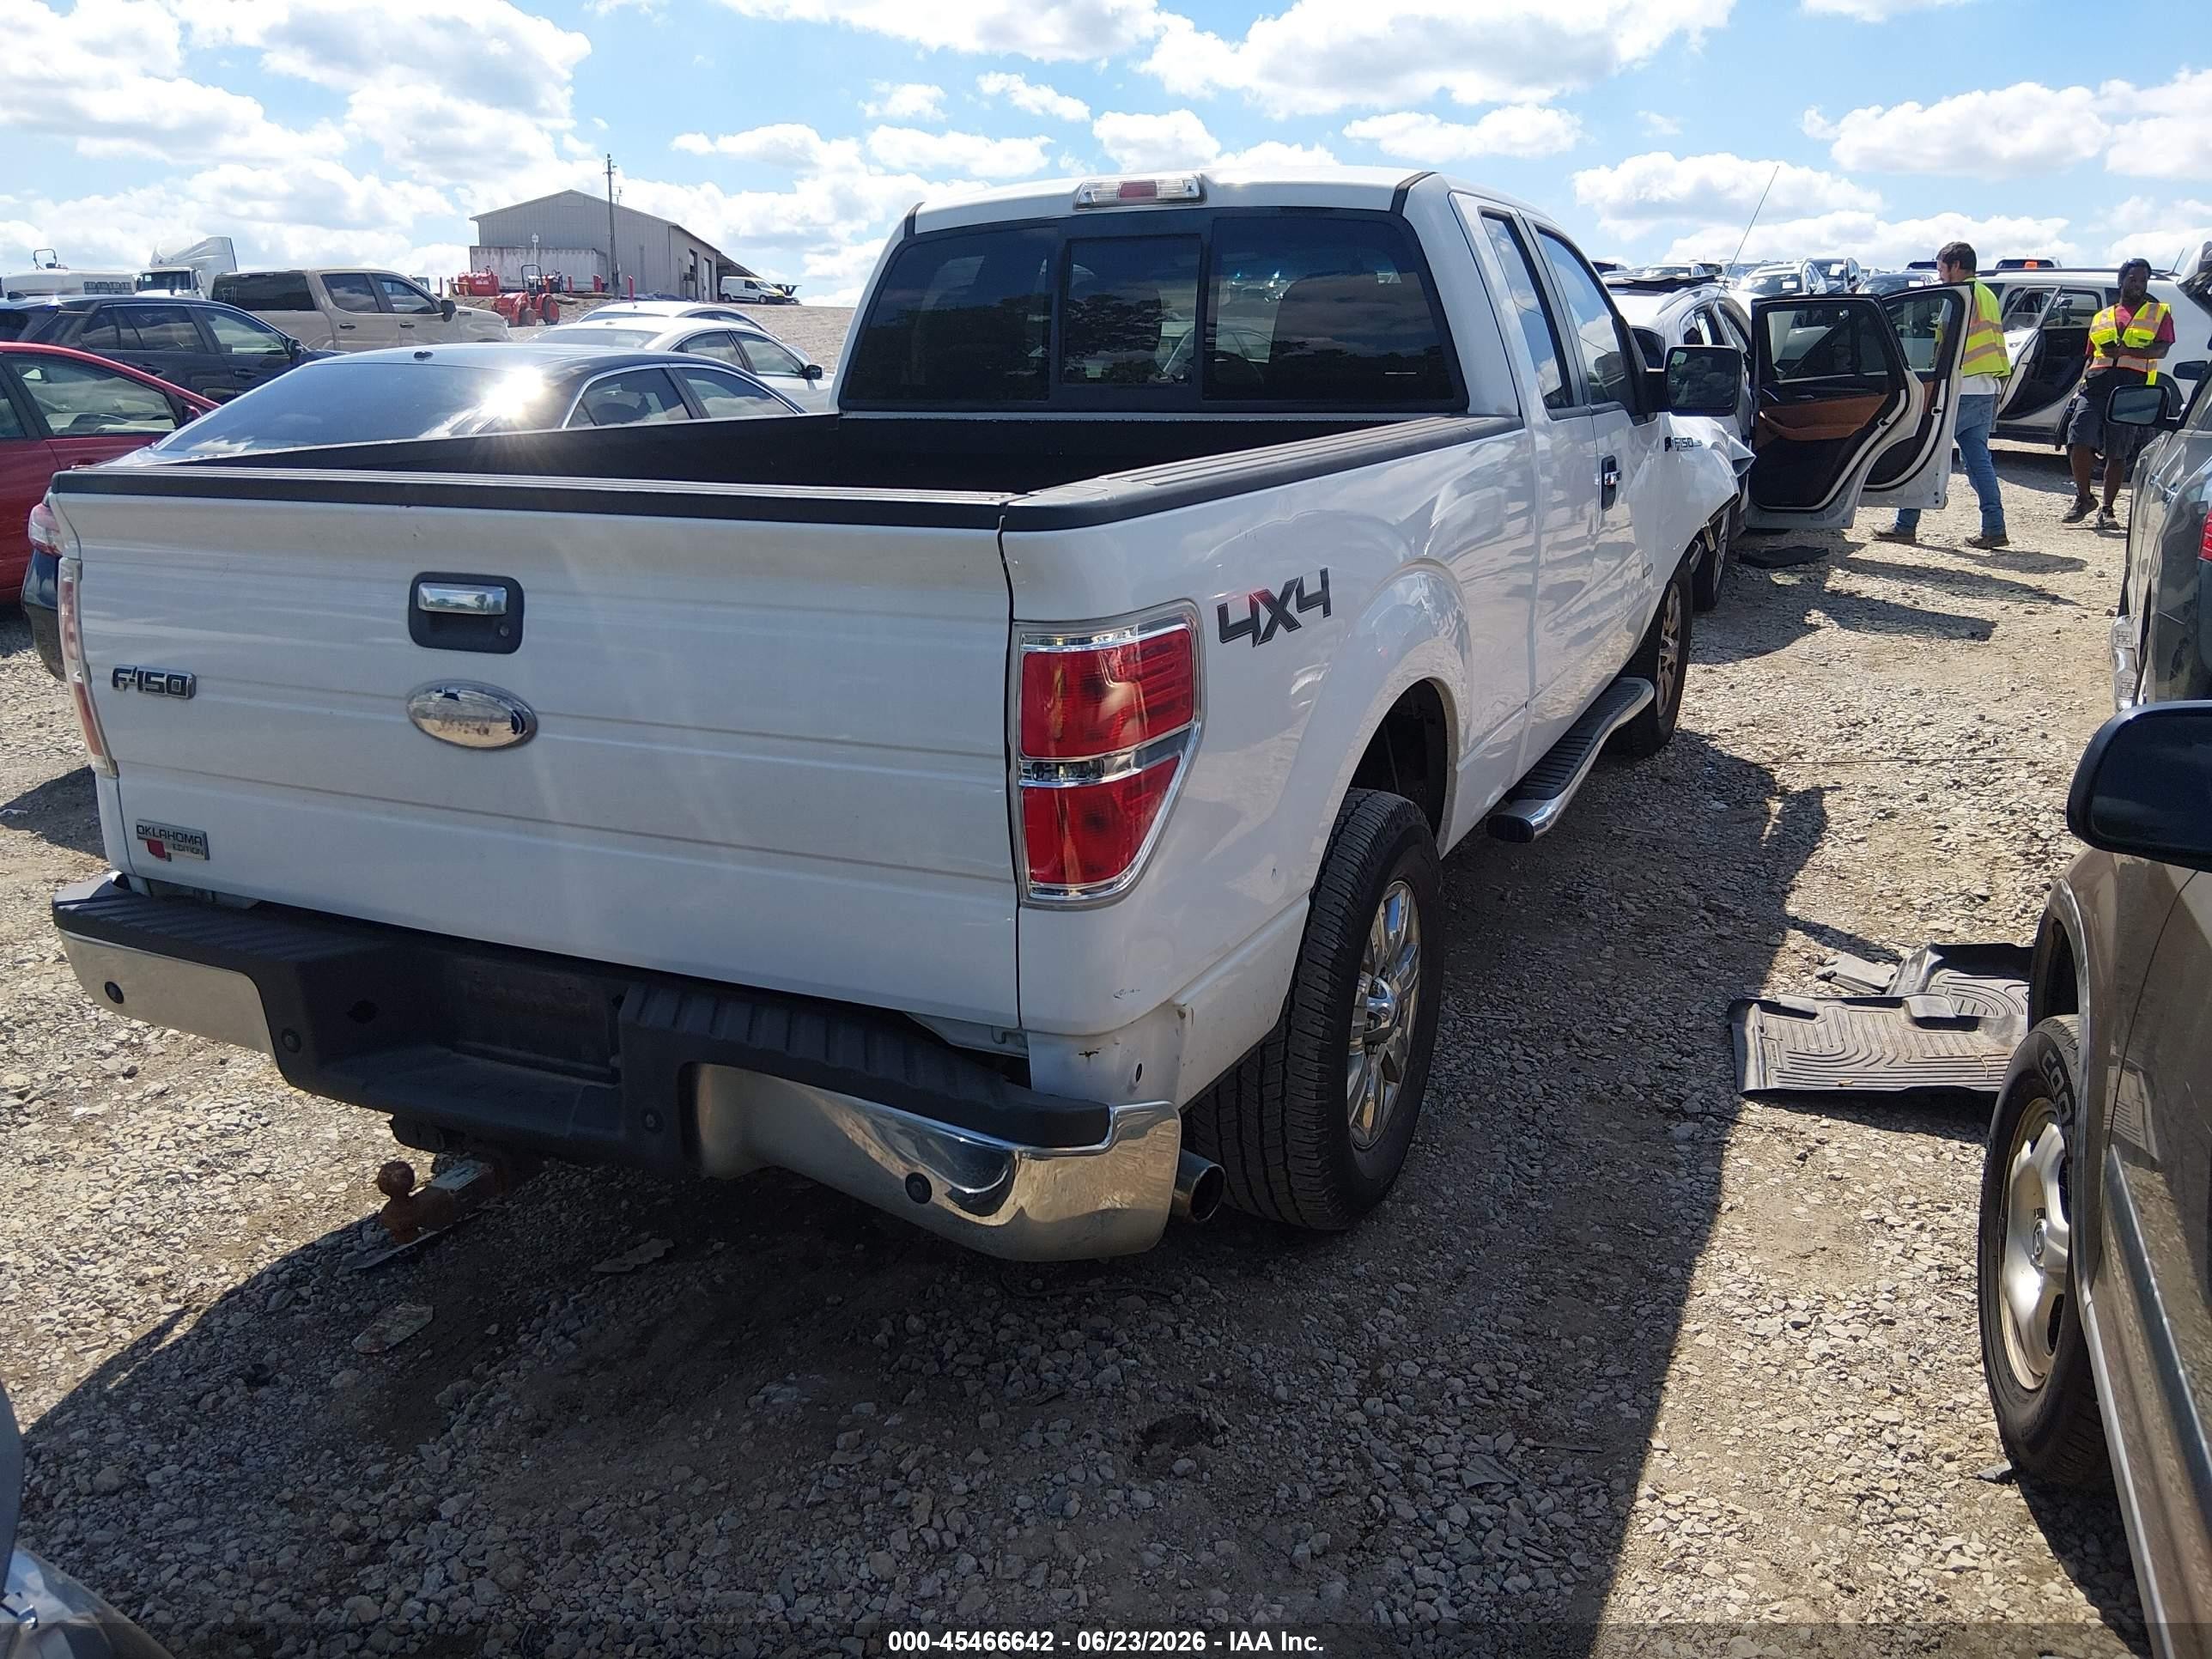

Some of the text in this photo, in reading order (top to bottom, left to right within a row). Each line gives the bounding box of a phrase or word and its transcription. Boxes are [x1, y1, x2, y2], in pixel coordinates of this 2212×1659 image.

[1217, 568, 1331, 647] 4X4
[112, 665, 192, 697] F-150
[137, 824, 203, 846] OKLAHOMA
[172, 842, 204, 855] EDITION
